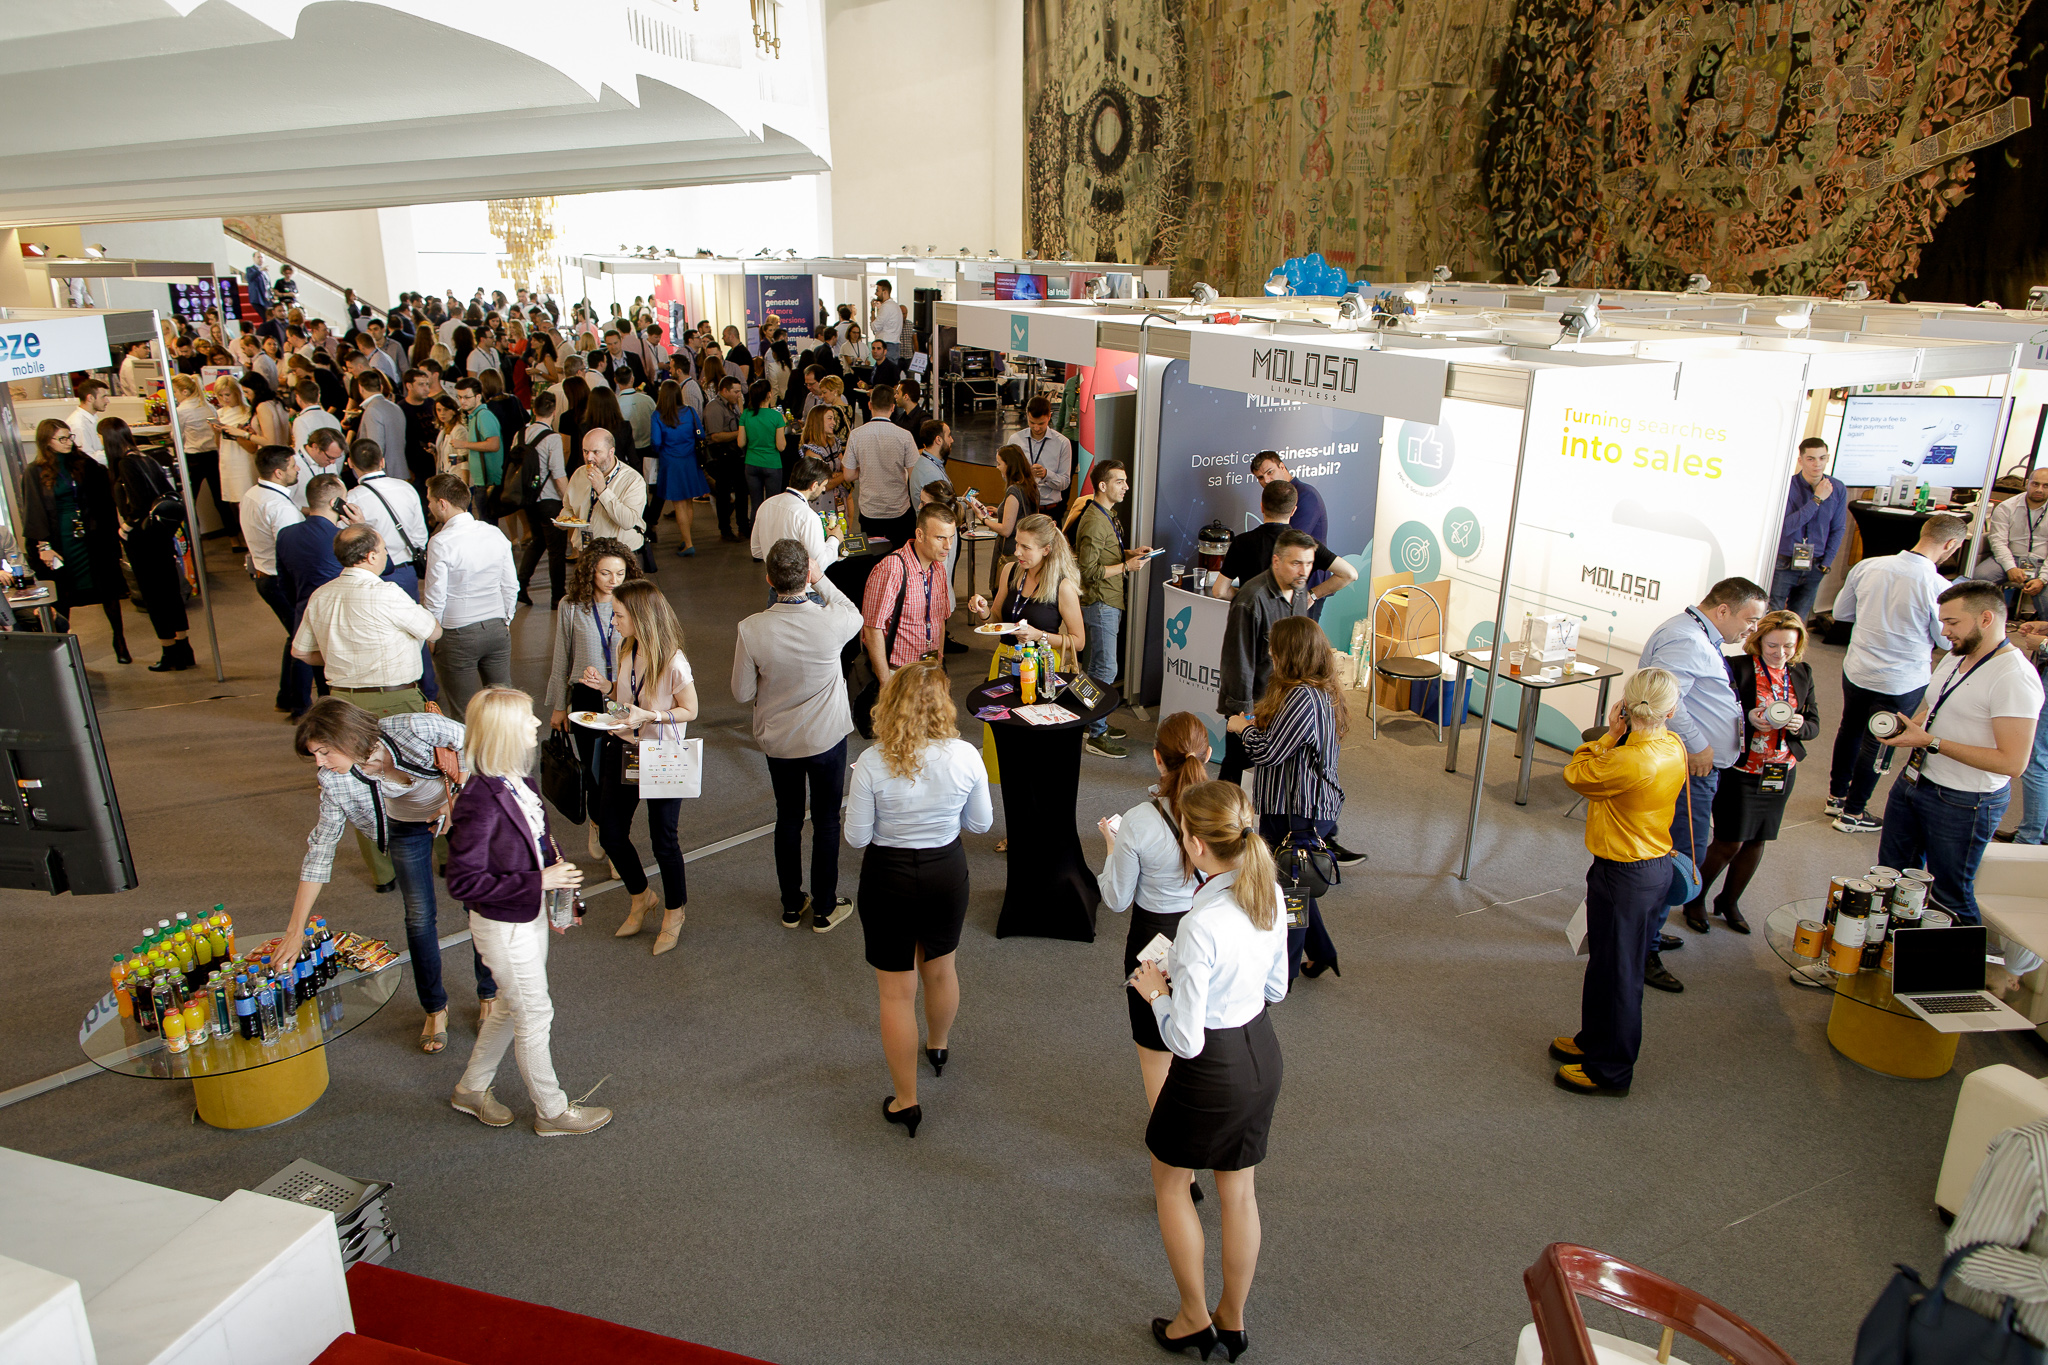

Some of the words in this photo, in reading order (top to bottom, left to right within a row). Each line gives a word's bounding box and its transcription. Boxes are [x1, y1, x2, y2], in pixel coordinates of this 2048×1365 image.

[765, 299, 799, 308] generated
[12, 361, 45, 377] mobile
[1252, 347, 1359, 394] MOLOSO
[1270, 385, 1337, 402] LIMITLESS
[1259, 405, 1302, 413] LIMITLESS
[1564, 407, 1632, 434] Turning
[1638, 420, 1728, 442] searches
[1191, 451, 1239, 468] Doresti
[1261, 442, 1336, 460] siness-ul
[1337, 442, 1360, 455] tau
[1561, 426, 1623, 464] into
[1632, 443, 1723, 480] sales
[1207, 476, 1222, 487] sa
[1225, 471, 1243, 486] fie
[1288, 461, 1342, 479] ofitabil?
[1581, 564, 1661, 602] MOLOSO
[1595, 587, 1645, 604] LIMITLESS
[1166, 656, 1221, 689] MOLOS
